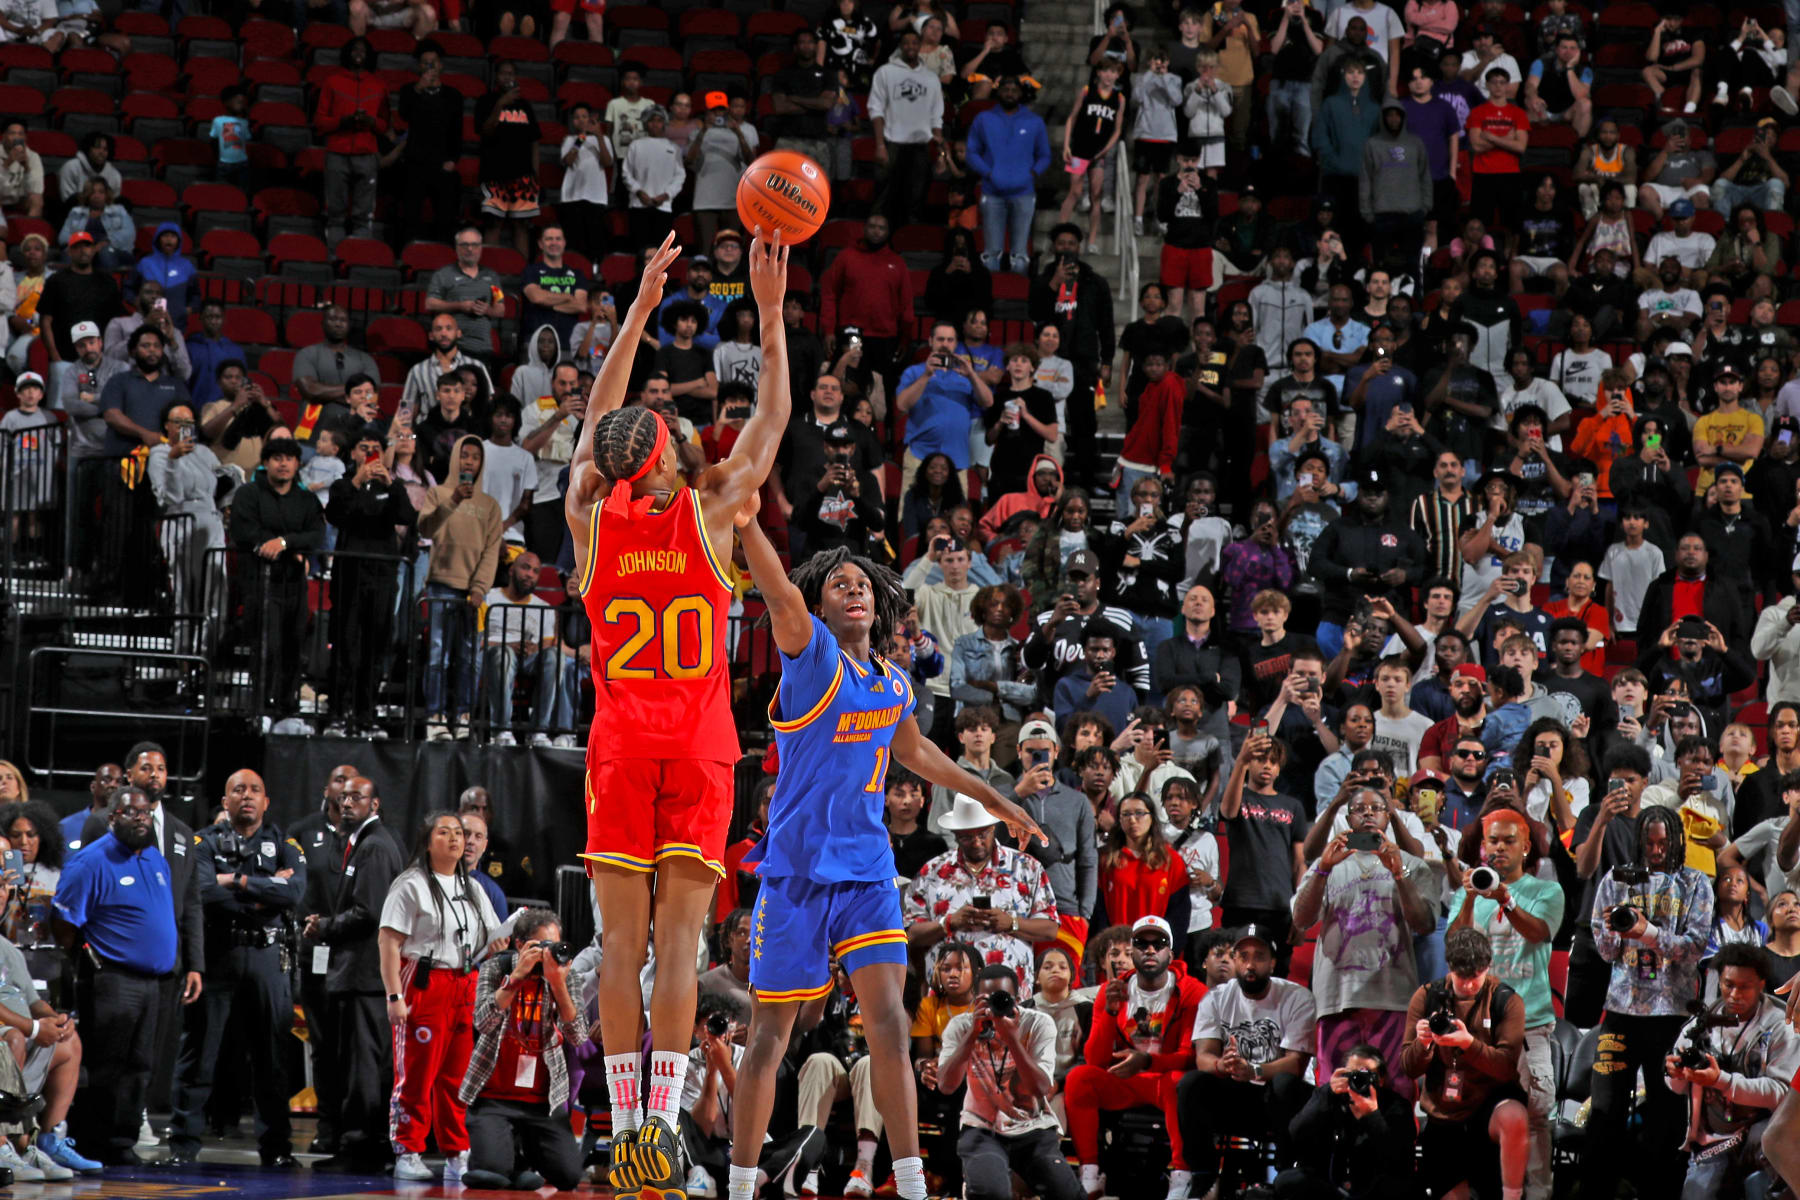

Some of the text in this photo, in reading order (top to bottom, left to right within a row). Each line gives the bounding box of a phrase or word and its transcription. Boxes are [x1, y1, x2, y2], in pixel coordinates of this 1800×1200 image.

[1087, 104, 1115, 120] PHX
[766, 173, 817, 217] Wilson
[709, 282, 744, 296] SOUTH
[617, 550, 687, 577] JOHNSON
[603, 593, 714, 680] 20
[832, 731, 873, 743] ALL AMERICAN
